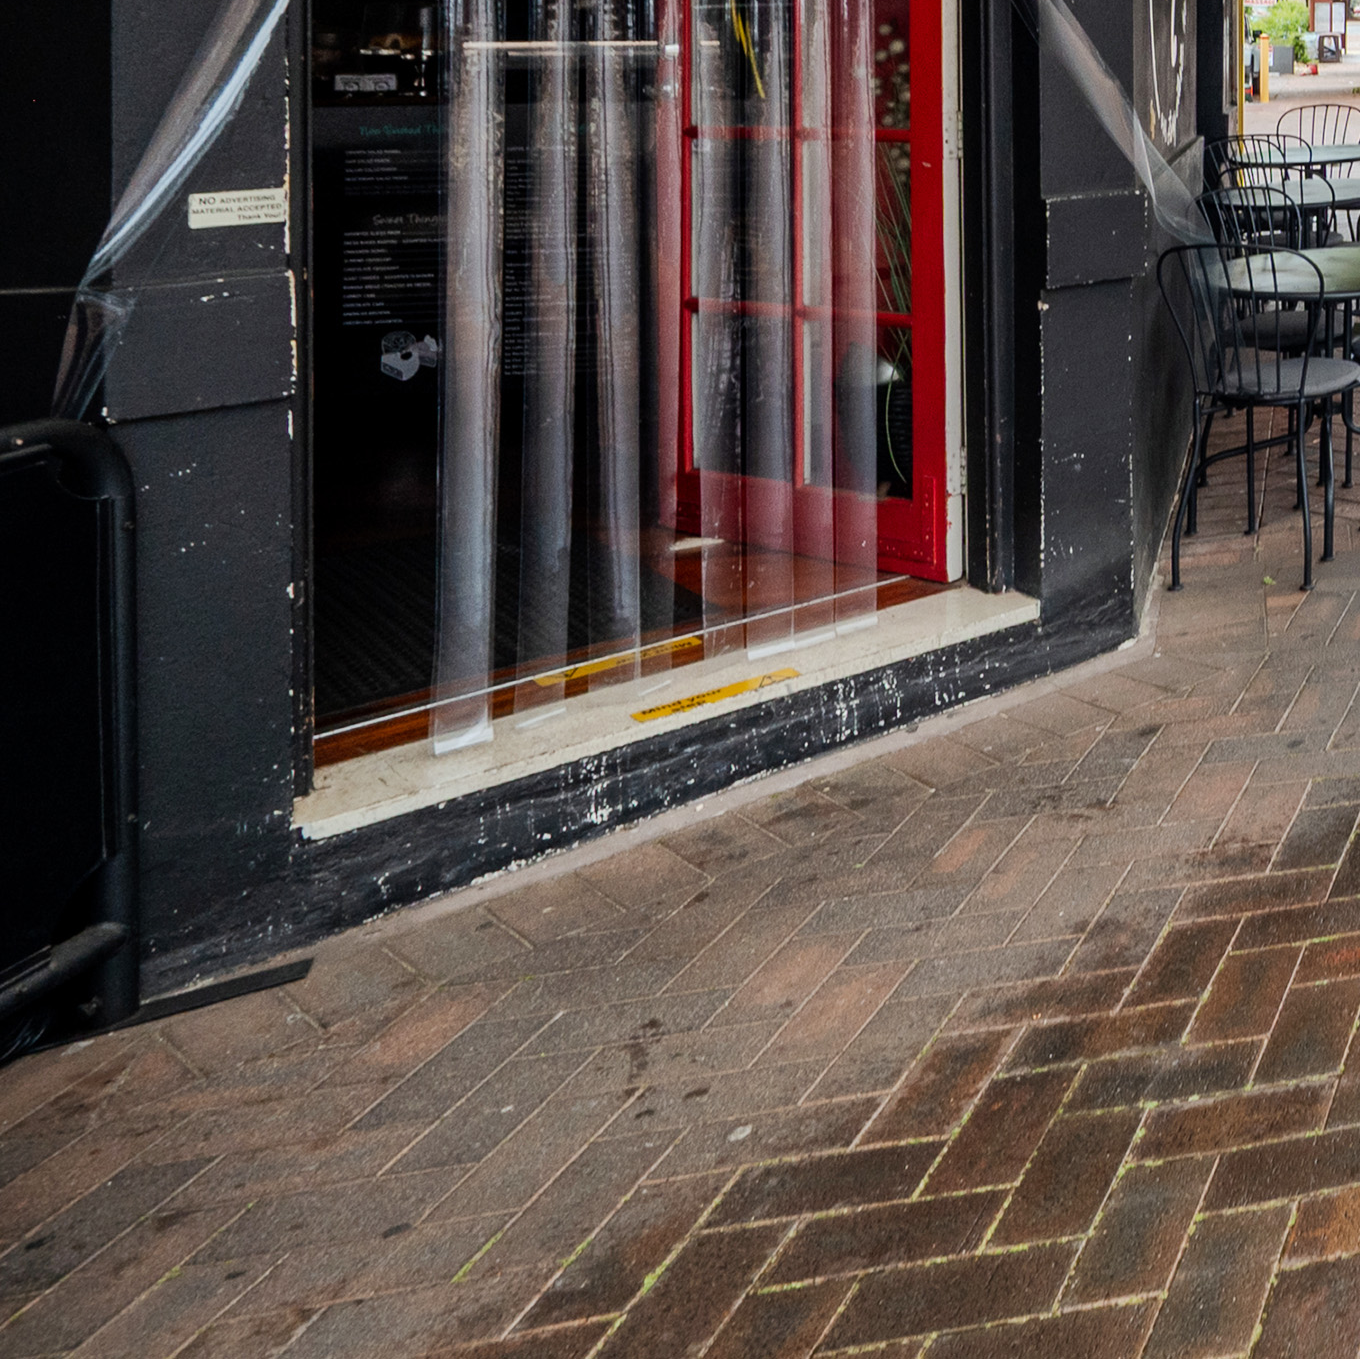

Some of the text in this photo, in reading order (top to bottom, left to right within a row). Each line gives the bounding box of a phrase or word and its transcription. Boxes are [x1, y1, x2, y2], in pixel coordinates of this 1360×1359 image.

[199, 194, 276, 206] NO ADVERTISING
[191, 203, 282, 215] MATERIAL ACCEPTED
[641, 688, 721, 715] Mind your
